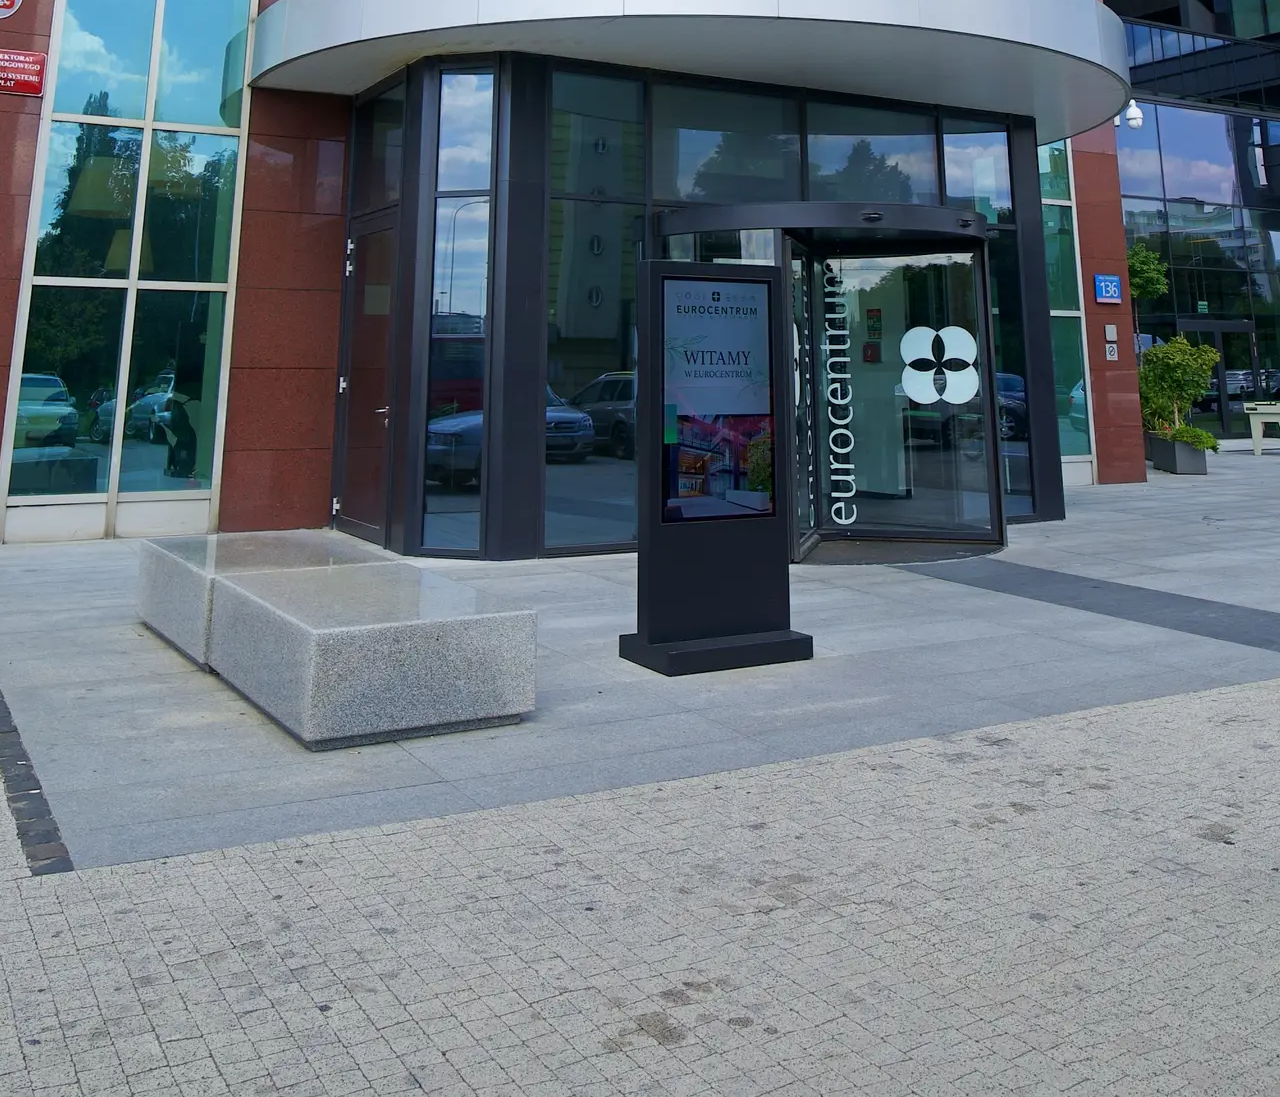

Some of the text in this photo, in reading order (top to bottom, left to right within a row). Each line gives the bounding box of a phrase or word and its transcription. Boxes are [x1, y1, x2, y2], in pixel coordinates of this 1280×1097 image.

[7, 73, 40, 82] SYSTEMU
[1099, 281, 1119, 297] 136
[676, 304, 758, 316] EUROCENTRUM
[683, 350, 751, 366] WITAMY
[684, 370, 752, 378] W EUROCENTRUM
[820, 258, 857, 525] eurocentrum
